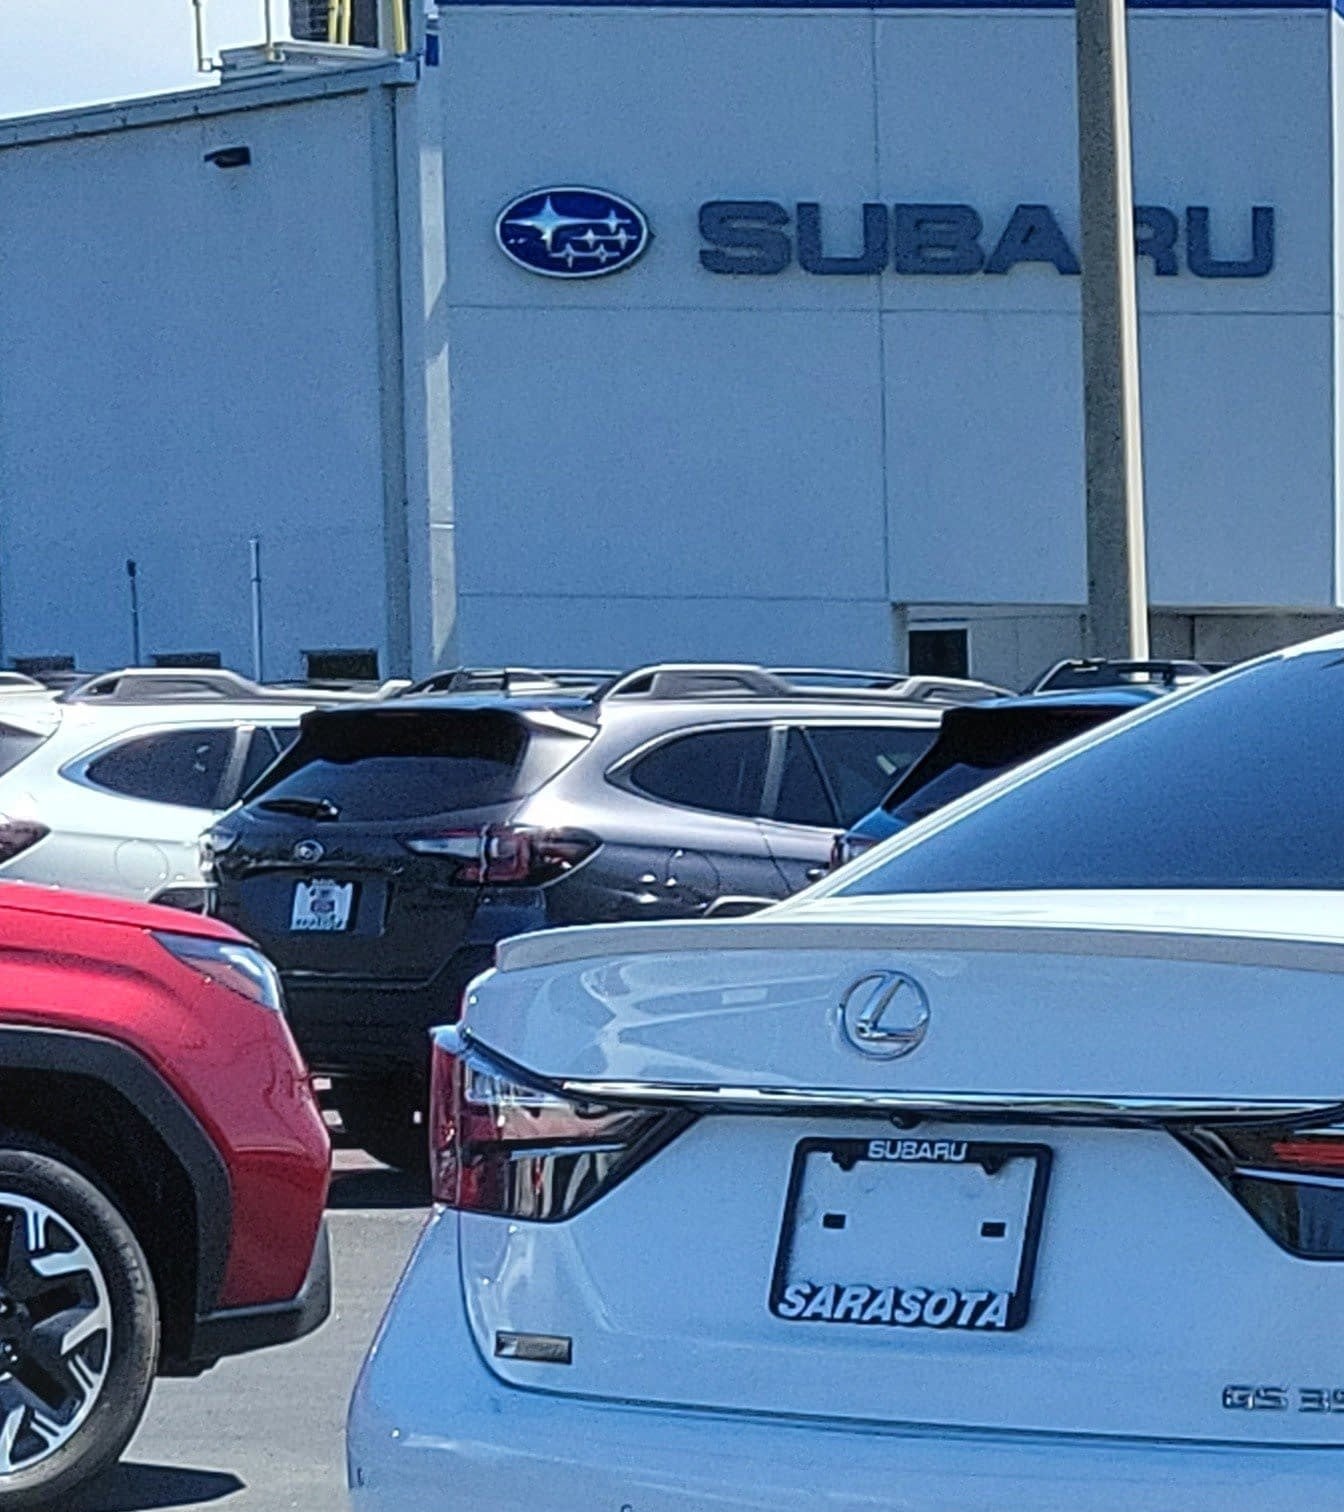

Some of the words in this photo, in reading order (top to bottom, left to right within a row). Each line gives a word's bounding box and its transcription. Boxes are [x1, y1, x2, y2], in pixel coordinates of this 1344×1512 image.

[867, 1140, 968, 1161] SUBARU
[777, 1281, 1010, 1327] SARASOTA
[1222, 1384, 1288, 1411] GS
